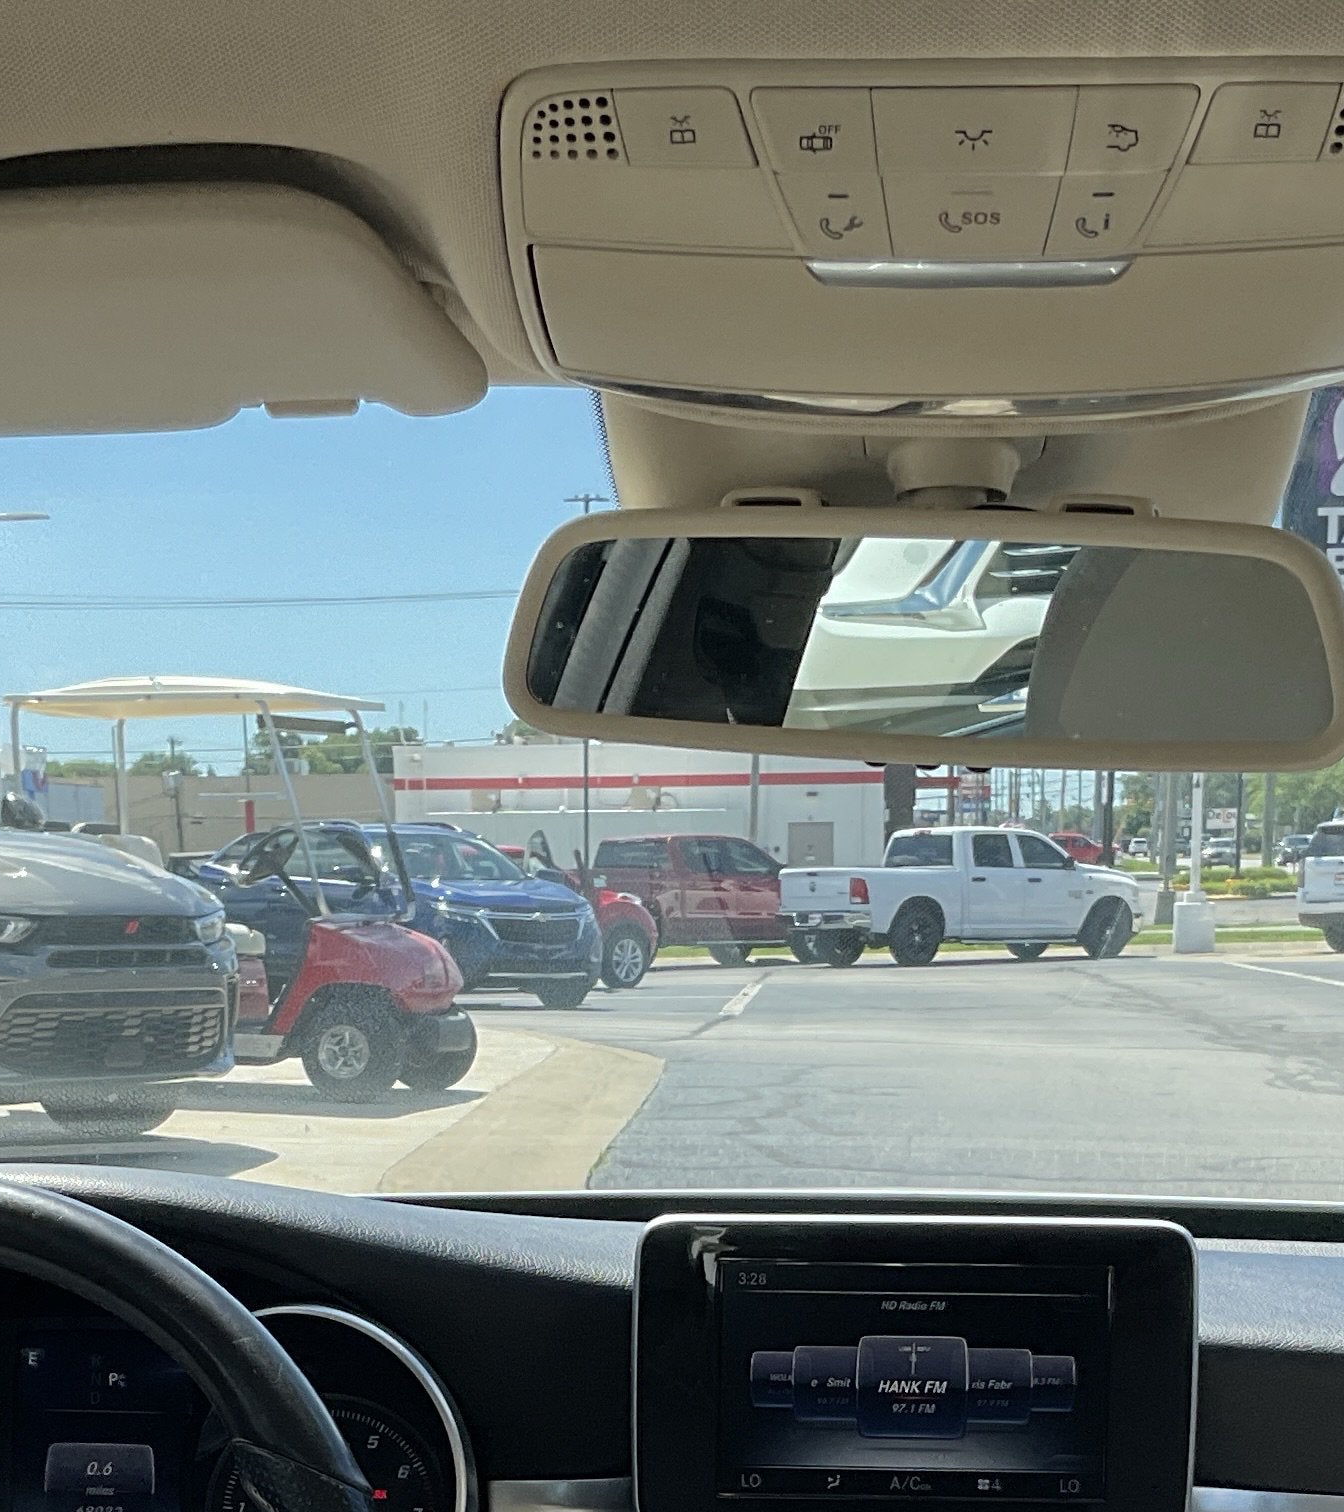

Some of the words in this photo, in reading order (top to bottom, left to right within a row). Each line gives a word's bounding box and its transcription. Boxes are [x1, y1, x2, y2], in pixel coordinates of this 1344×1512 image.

[818, 124, 841, 135] OFF
[961, 211, 1001, 226] SOS
[738, 1272, 768, 1286] 3:28
[881, 1300, 898, 1310] HD
[898, 1300, 928, 1310] Radio
[929, 1300, 946, 1310] FM
[28, 1352, 38, 1366] E
[878, 1380, 921, 1394] HANK
[924, 1380, 948, 1394] FM
[892, 1403, 916, 1414] 97.1
[917, 1403, 937, 1414] FM
[367, 1435, 380, 1449] 5
[86, 1461, 113, 1476] 0.6
[397, 1465, 411, 1479] 6
[741, 1473, 762, 1488] LO
[889, 1476, 920, 1490] A/C
[1059, 1479, 1080, 1493] LO
